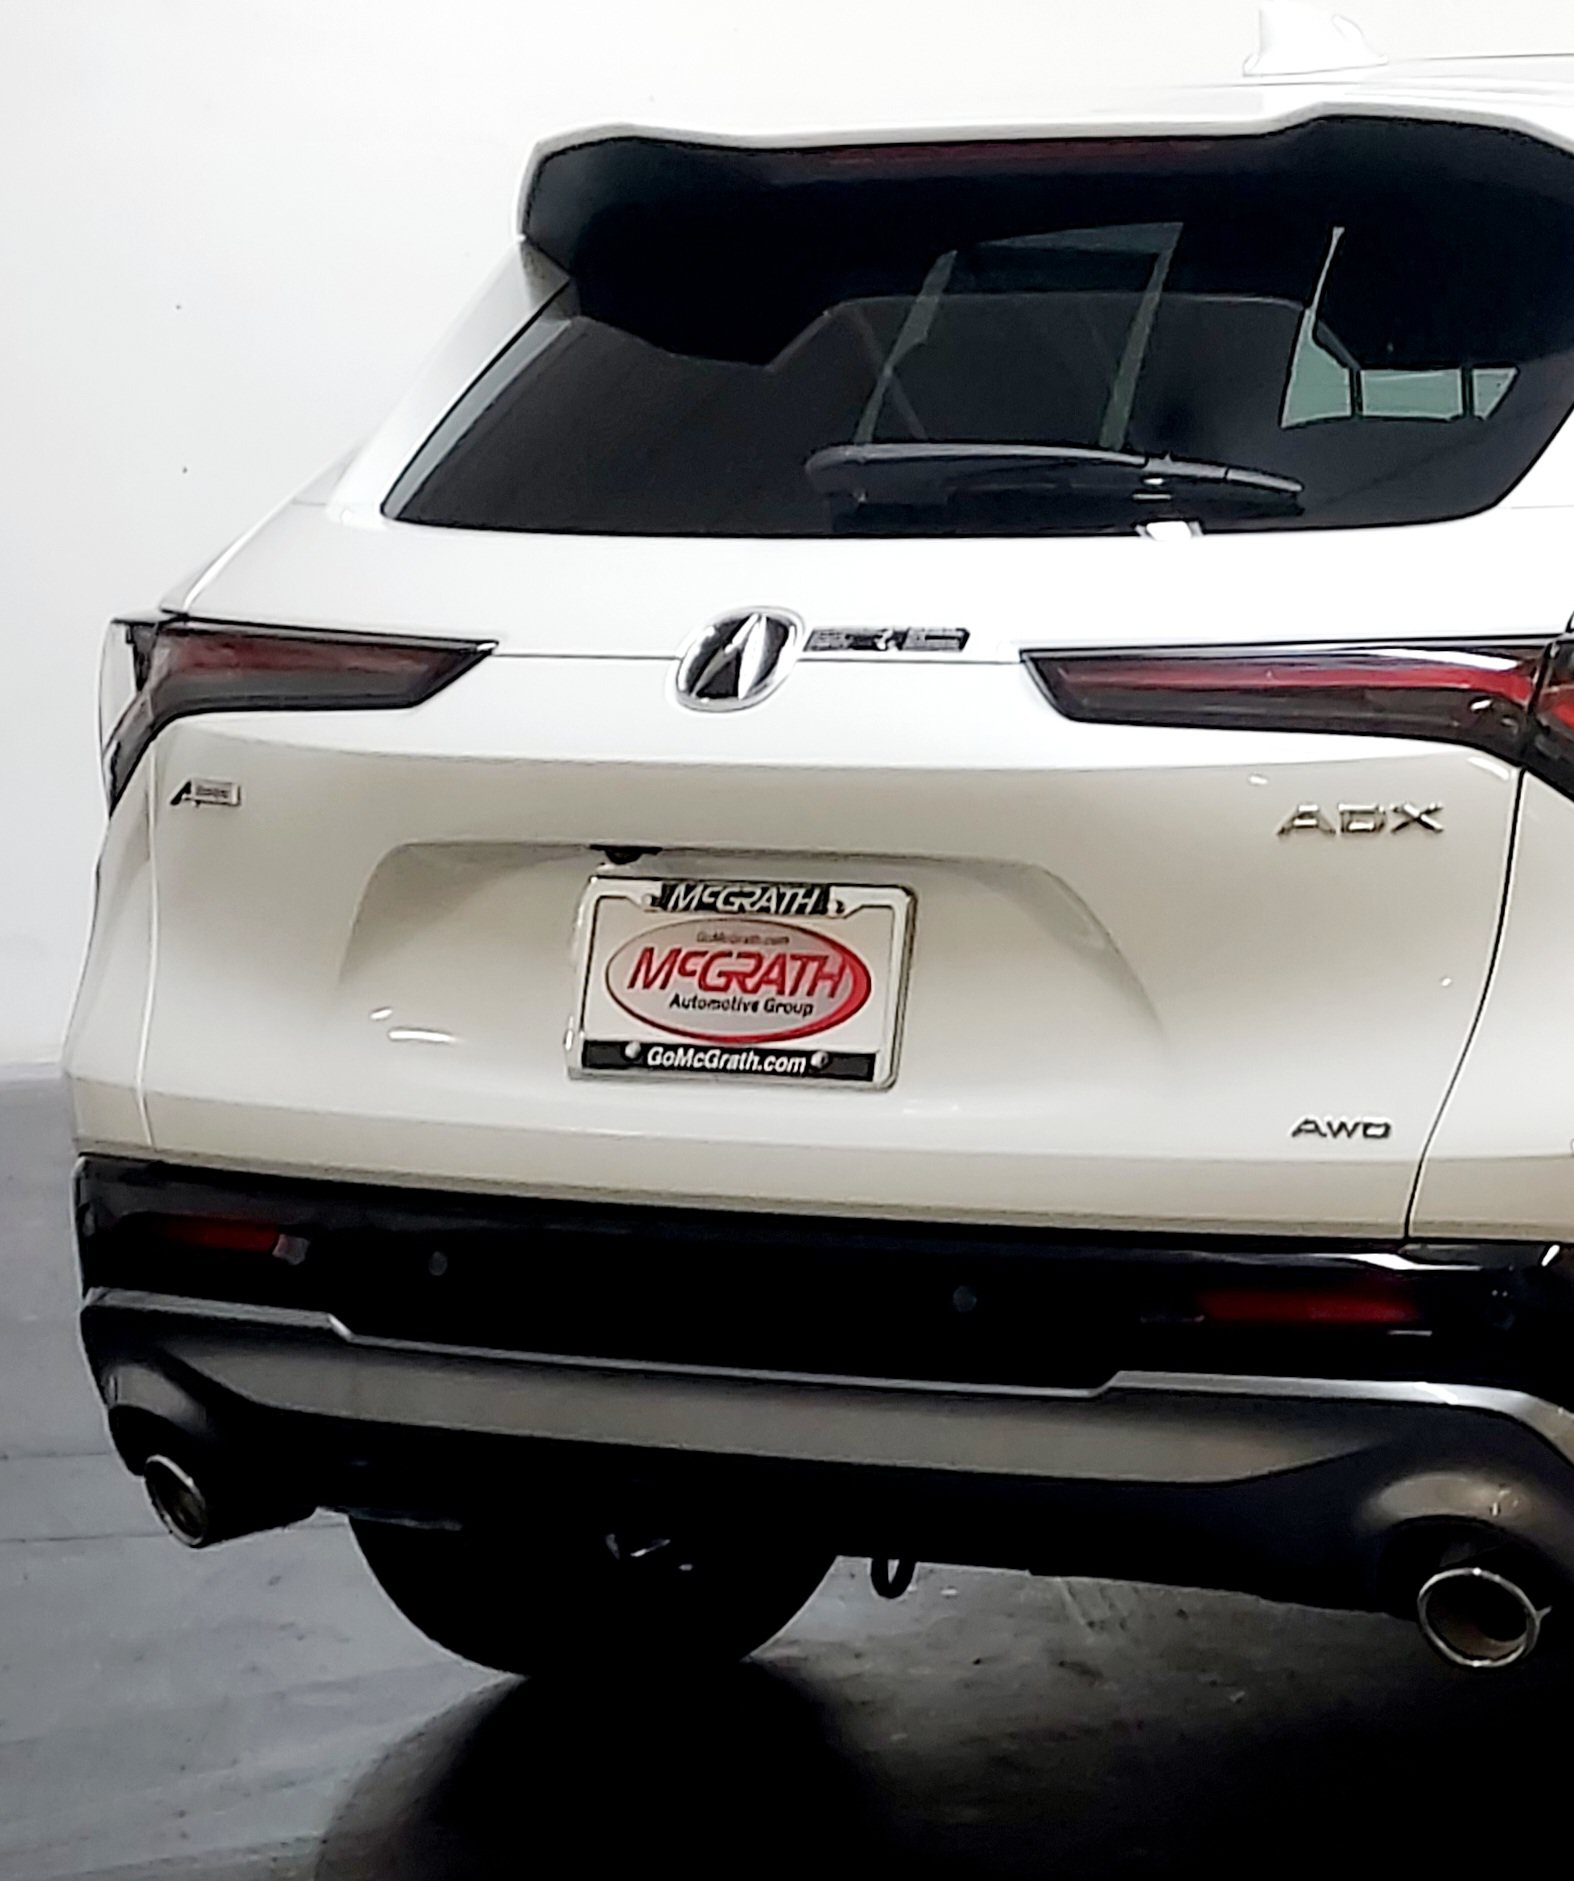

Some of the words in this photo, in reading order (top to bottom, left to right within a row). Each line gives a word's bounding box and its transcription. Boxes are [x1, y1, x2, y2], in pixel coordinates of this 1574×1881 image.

[669, 994, 760, 1014] Automotive
[764, 998, 814, 1018] Group
[647, 1046, 806, 1074] GoMcGrath.com
[1291, 1119, 1392, 1139] AWD
